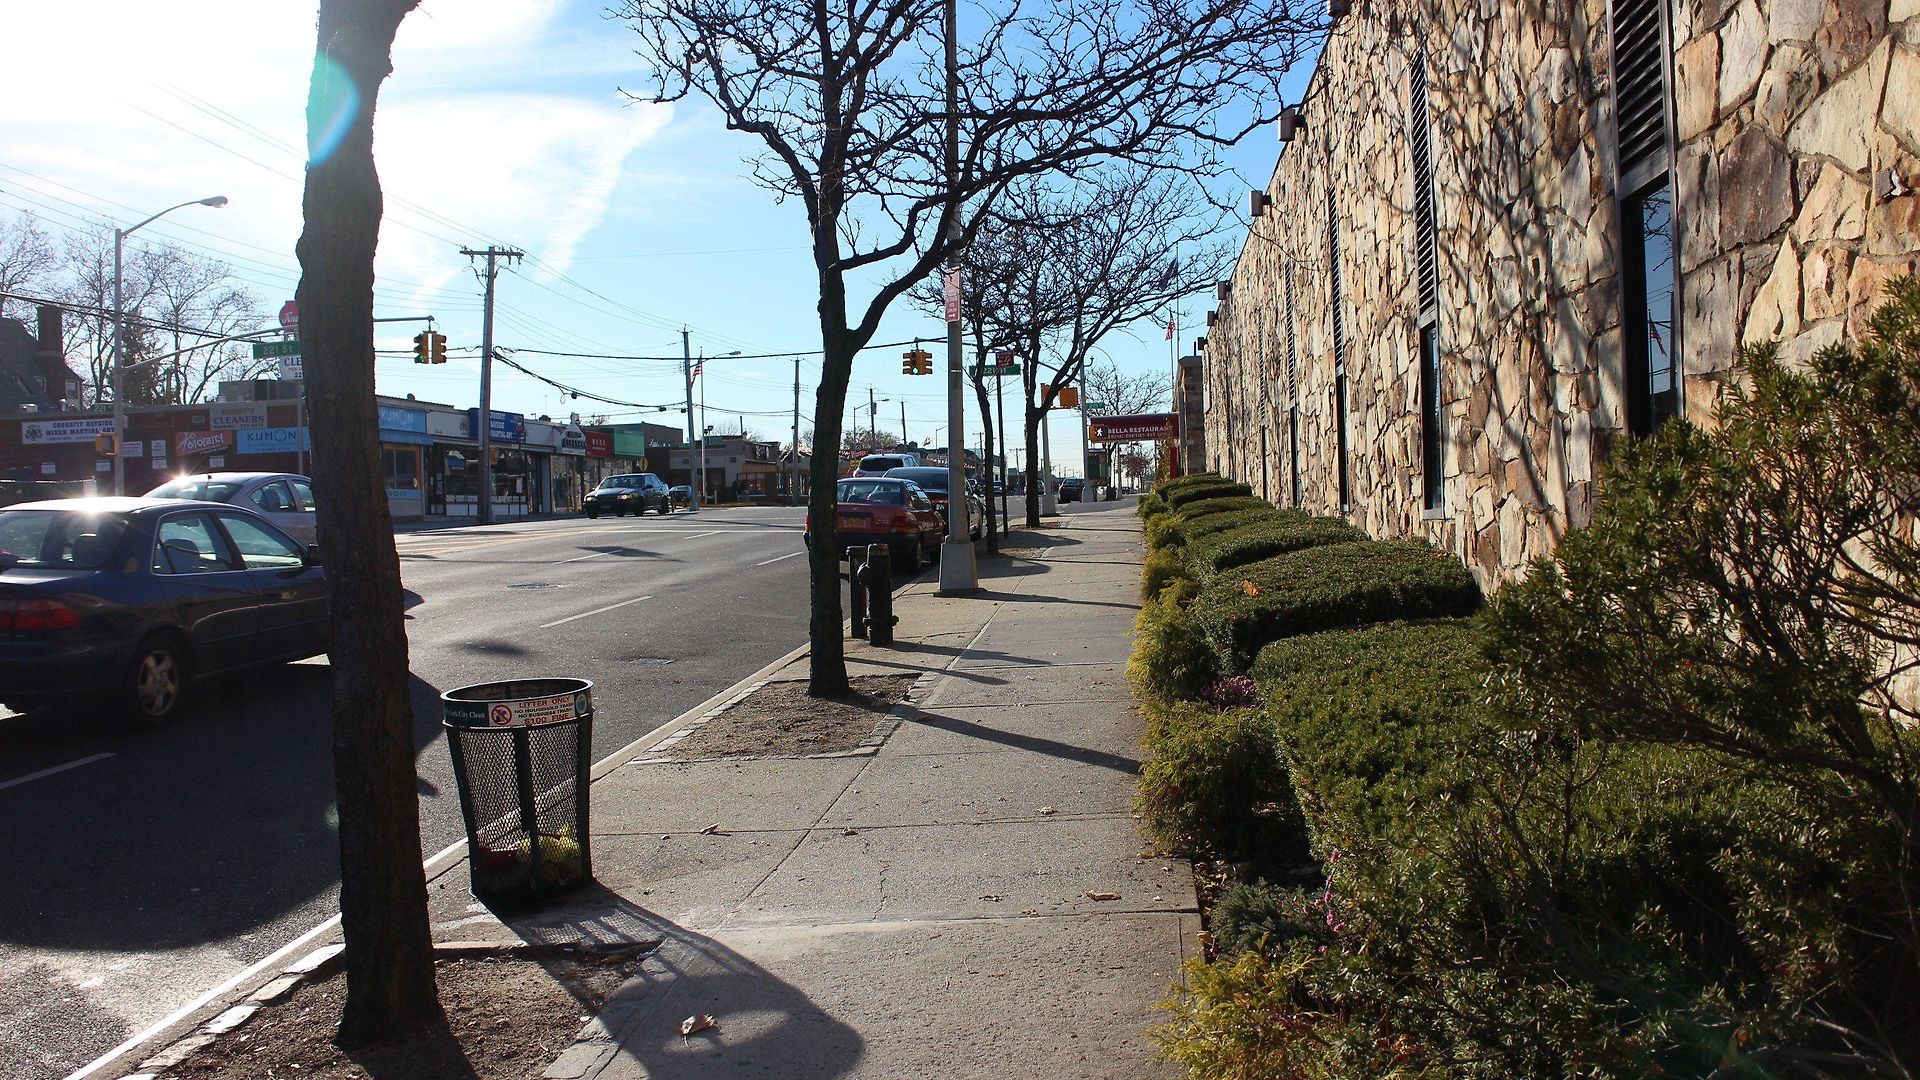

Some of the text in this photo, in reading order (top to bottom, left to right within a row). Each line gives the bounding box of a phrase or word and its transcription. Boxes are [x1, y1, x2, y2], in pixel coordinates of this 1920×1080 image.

[282, 345, 293, 353] St
[213, 415, 265, 424] CLEANERS
[381, 409, 414, 425] KUMON
[52, 421, 83, 429] CROSSFIT
[1129, 425, 1174, 433] RESTAURANT
[247, 429, 296, 442] KUMON
[518, 696, 571, 708] LITTER ONLY
[524, 705, 558, 713] HOUSEHOLD
[528, 710, 556, 718] BUSINESS
[524, 713, 570, 725] $100 FINE
